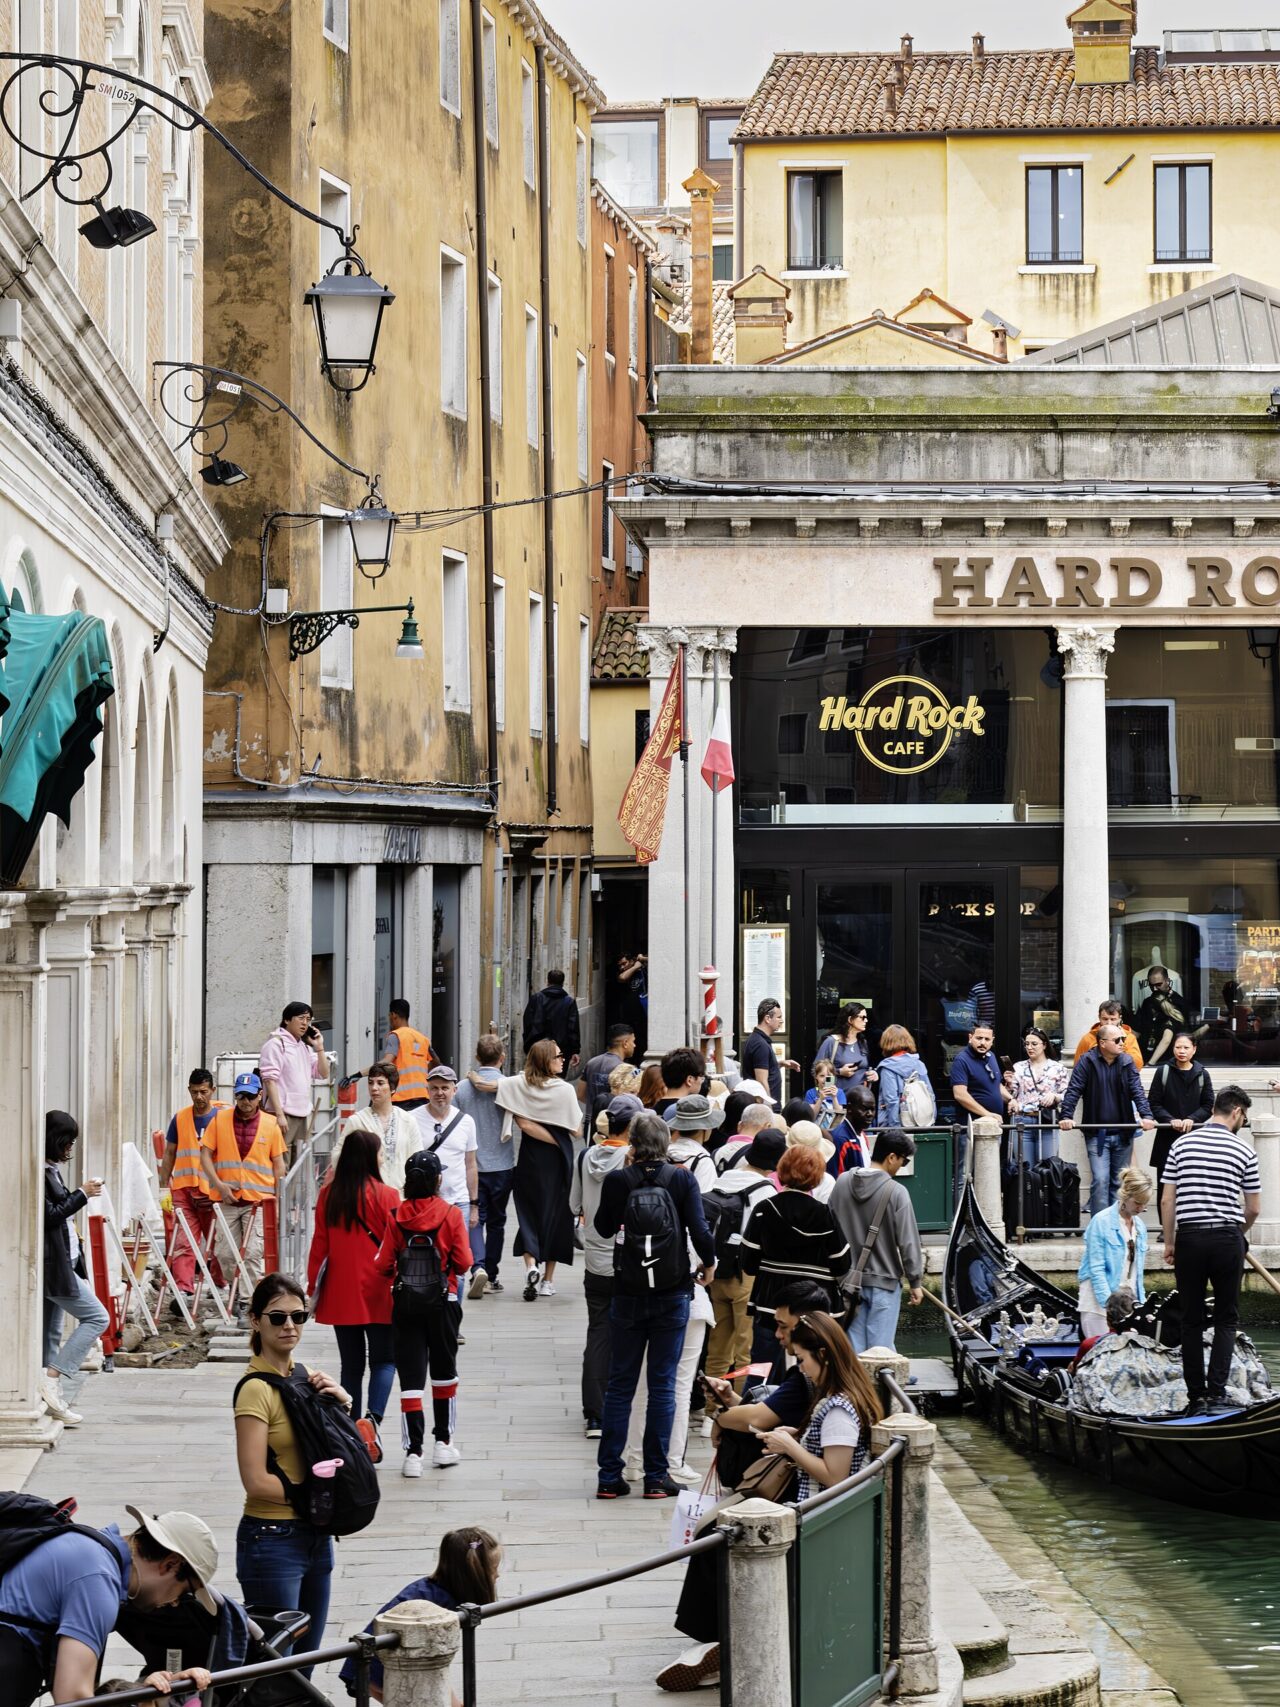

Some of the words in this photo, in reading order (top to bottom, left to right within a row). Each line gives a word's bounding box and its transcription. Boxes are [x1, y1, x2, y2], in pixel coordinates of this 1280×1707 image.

[933, 557, 1162, 607] HARD
[818, 695, 905, 731] Hard
[906, 695, 986, 737] Rock
[883, 742, 925, 755] CAFE
